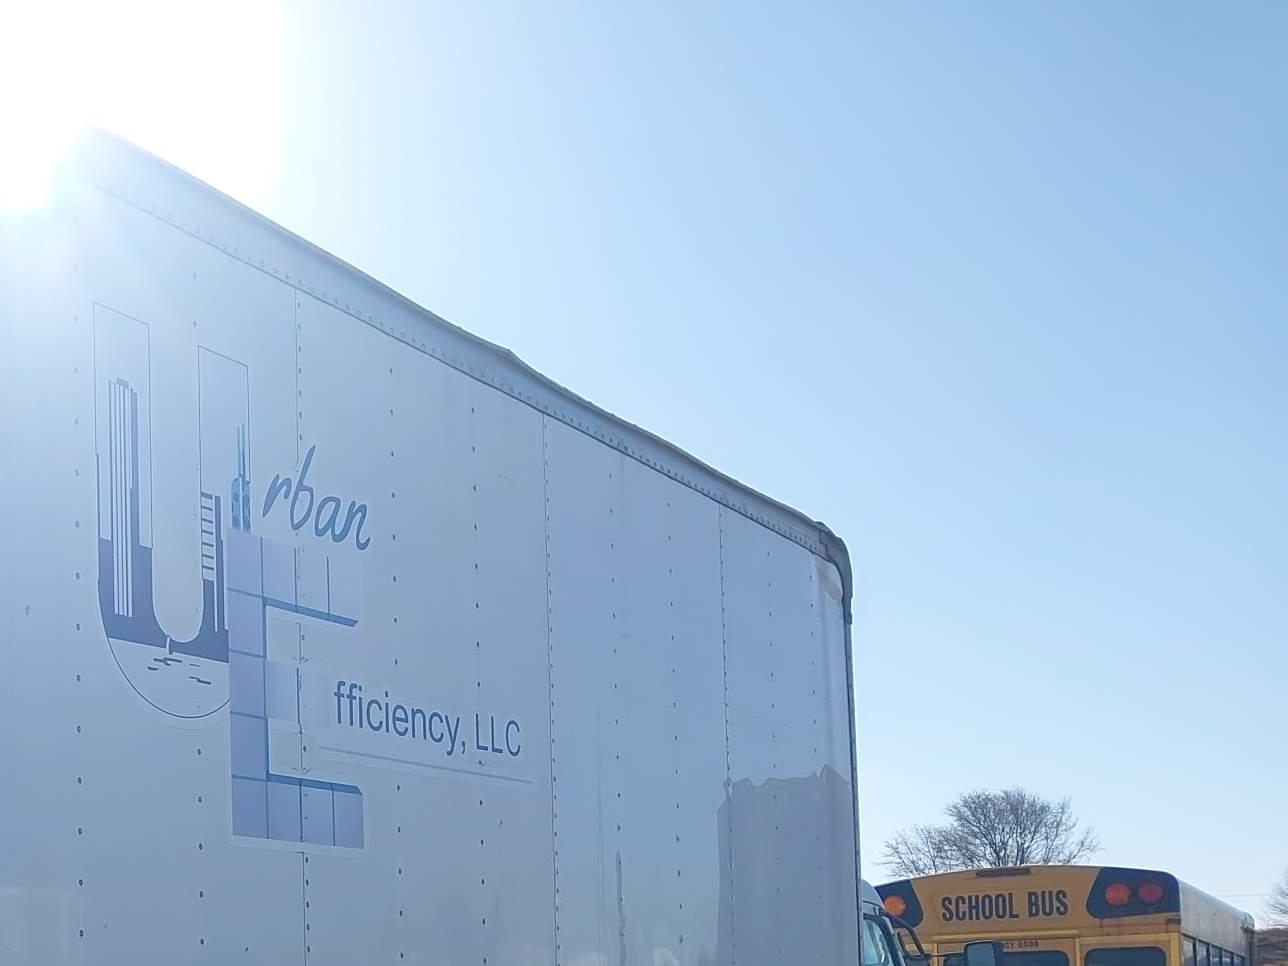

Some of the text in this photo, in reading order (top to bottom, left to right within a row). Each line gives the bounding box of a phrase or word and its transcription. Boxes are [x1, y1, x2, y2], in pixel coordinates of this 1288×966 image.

[475, 712, 521, 757] LLC
[941, 889, 1069, 922] SCHOOL BUS
